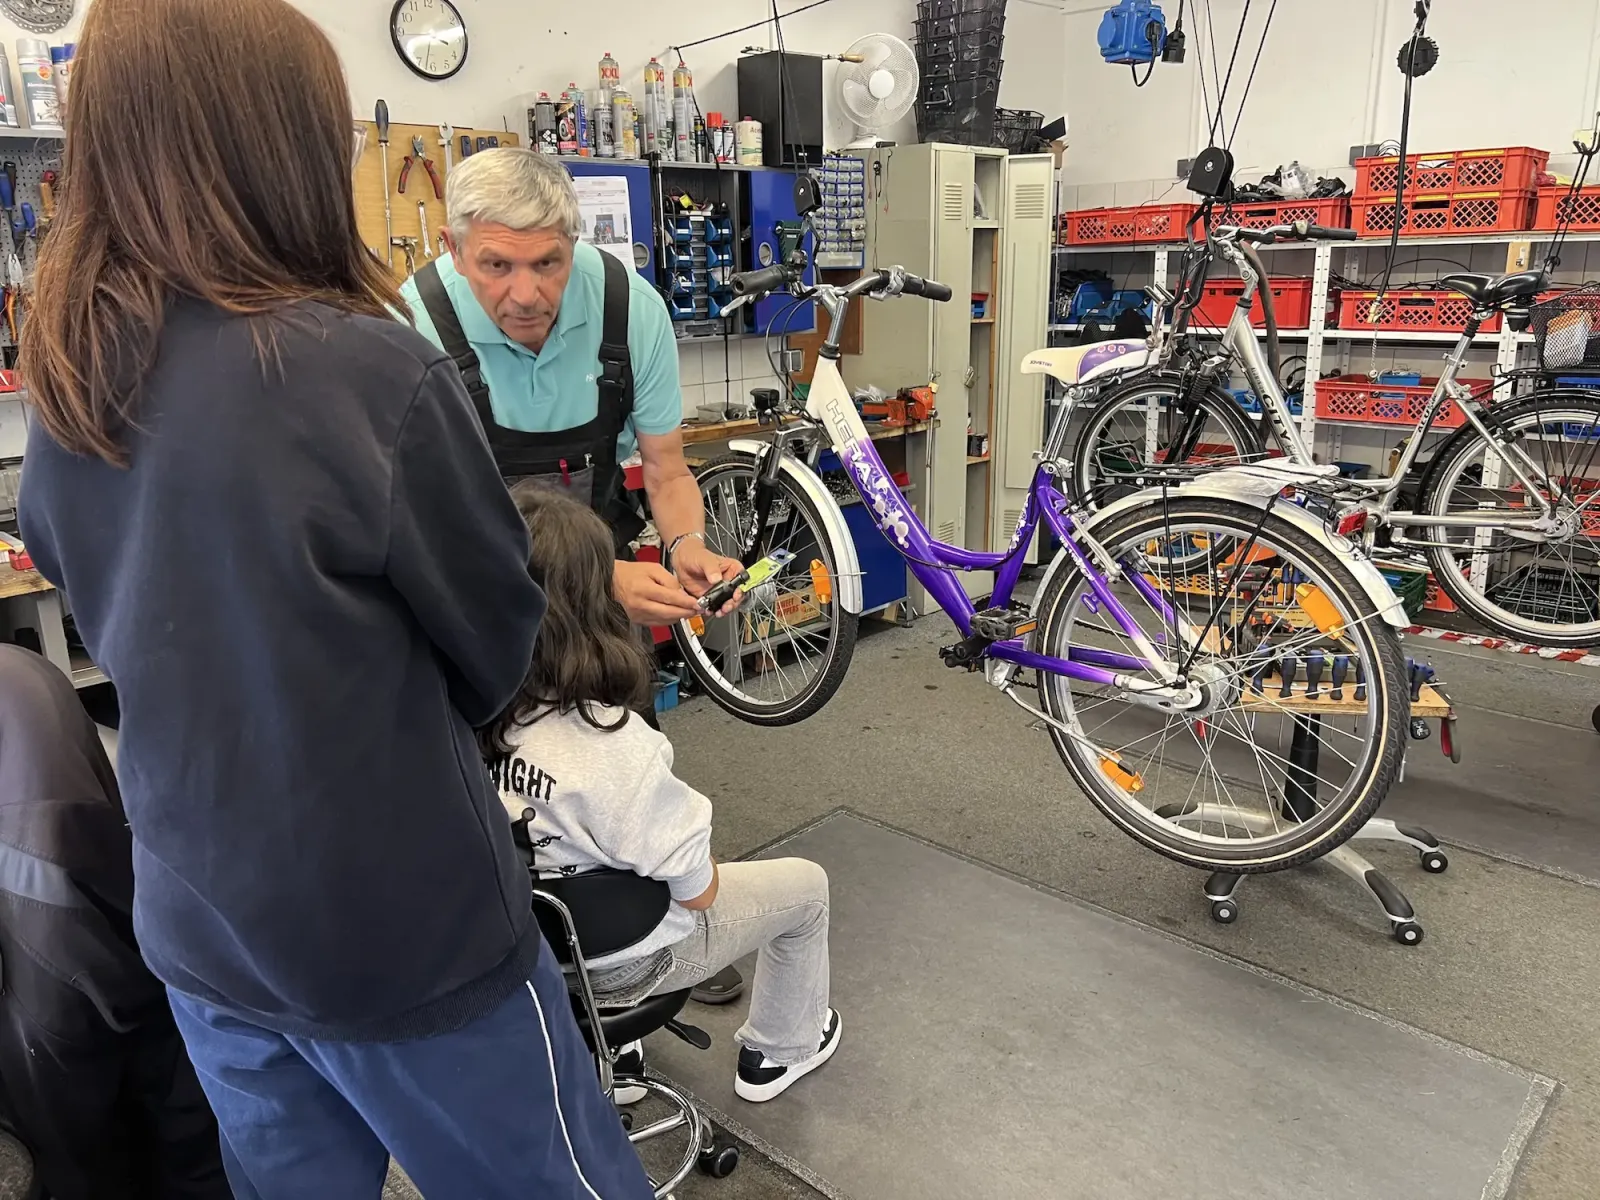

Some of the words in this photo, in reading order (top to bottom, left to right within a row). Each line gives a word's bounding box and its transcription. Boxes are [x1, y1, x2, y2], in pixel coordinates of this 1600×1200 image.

[410, 1, 418, 11] 11
[424, 0, 433, 8] 12
[440, 3, 445, 13] 1
[401, 12, 413, 23] 10
[449, 16, 455, 26] 2
[397, 27, 405, 37] 9
[451, 50, 457, 60] 4
[415, 56, 422, 66] 7
[443, 60, 450, 69] 5
[429, 62, 437, 72] 6
[601, 66, 620, 80] XXL
[1262, 393, 1292, 441] CITY
[777, 597, 794, 609] SWEET
[776, 604, 799, 617] PEPPERS
